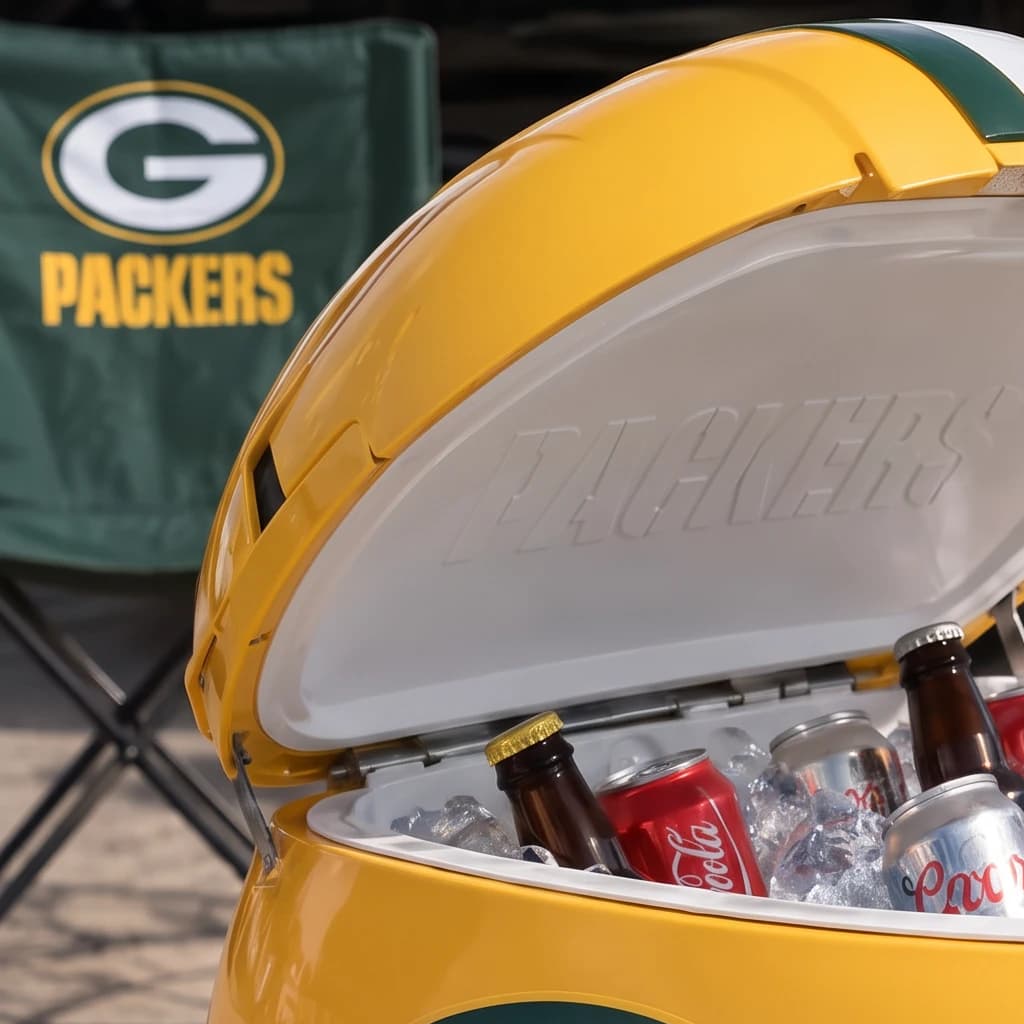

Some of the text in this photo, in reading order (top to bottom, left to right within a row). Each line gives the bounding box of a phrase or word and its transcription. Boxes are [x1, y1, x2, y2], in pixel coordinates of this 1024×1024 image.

[58, 95, 268, 232] G
[40, 250, 294, 328] PACKERS
[441, 385, 1024, 567] PACKERS
